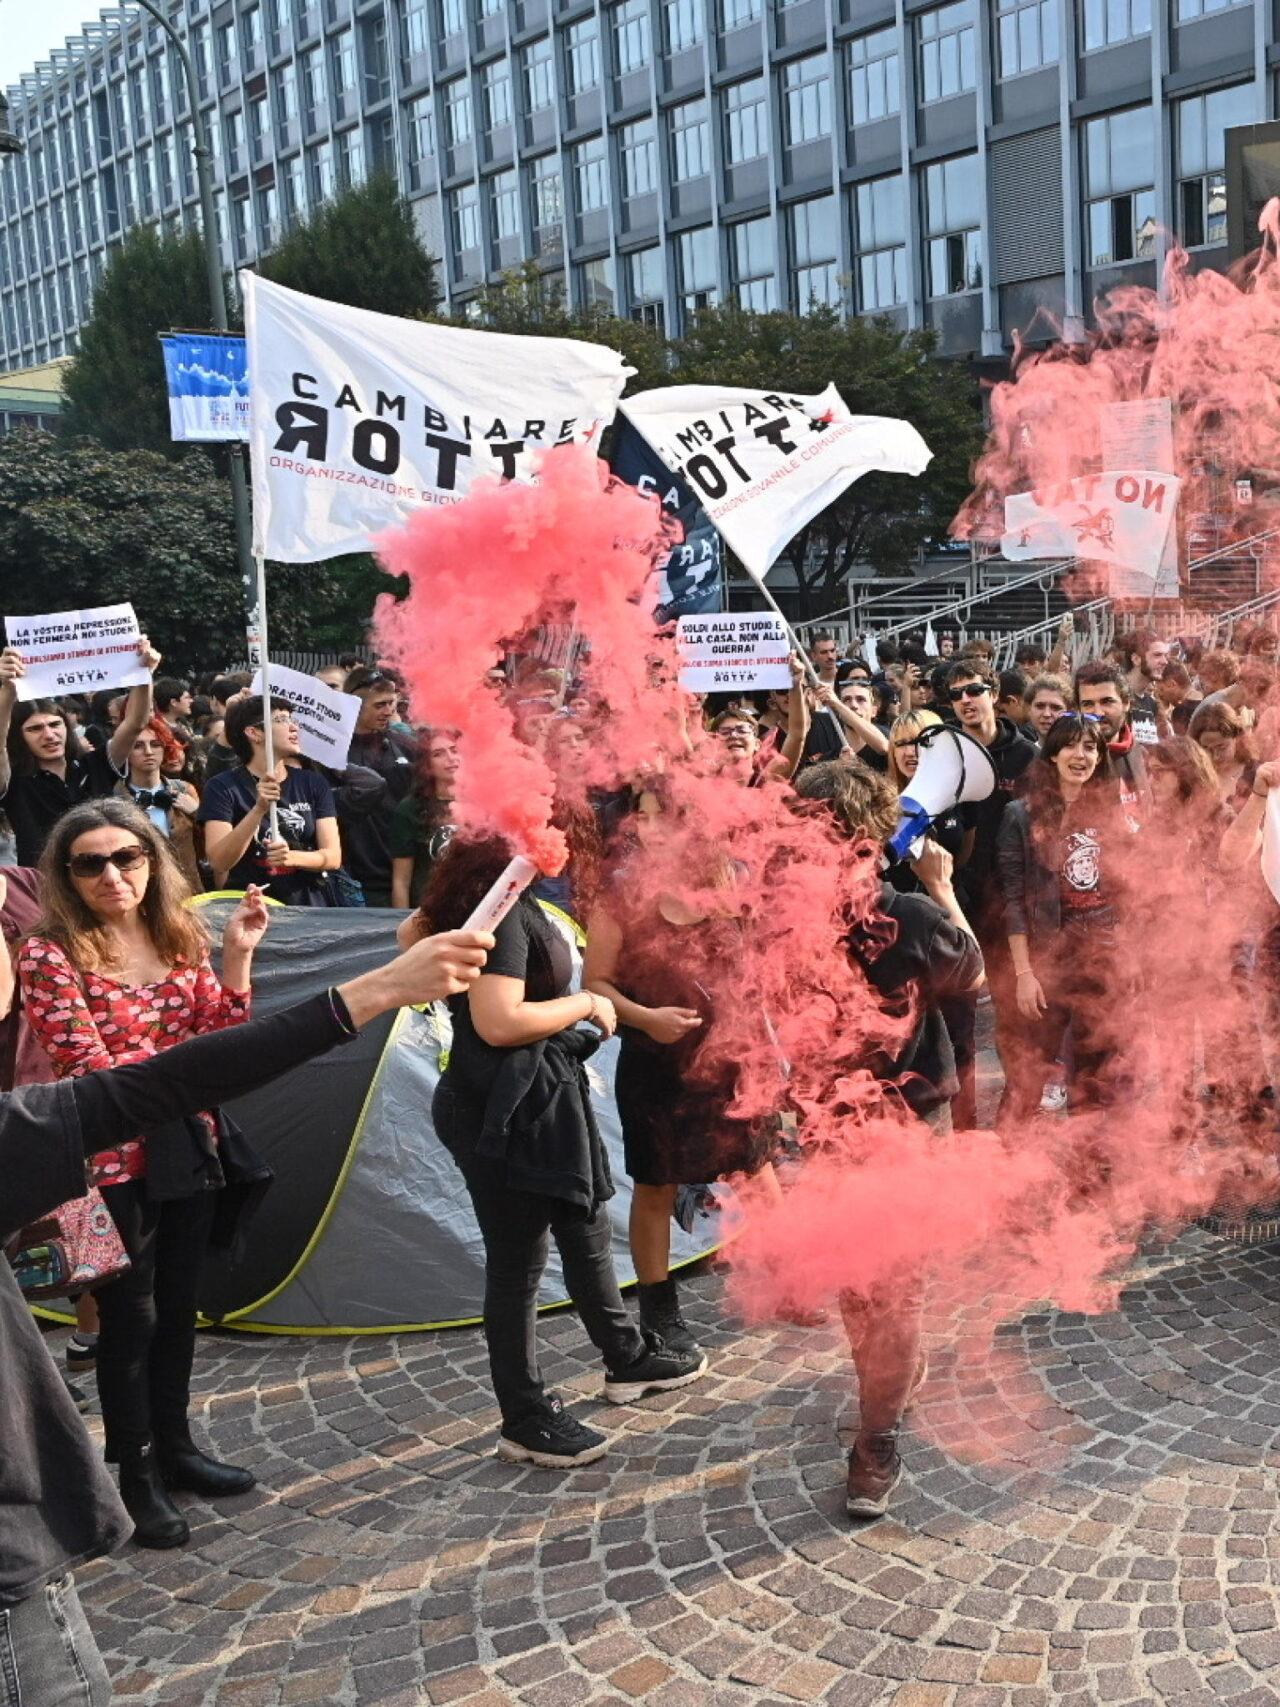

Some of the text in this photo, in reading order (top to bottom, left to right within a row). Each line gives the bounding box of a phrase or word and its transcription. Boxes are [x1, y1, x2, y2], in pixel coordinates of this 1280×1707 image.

[291, 371, 577, 441] CAMBIARE
[274, 400, 575, 491] ROTT
[269, 455, 416, 498] ORGANIZZAZIONE
[16, 628, 30, 638] LA
[33, 625, 71, 636] VOSTRA
[682, 621, 781, 633] SOLDI ALLO STUDIO E
[10, 637, 31, 647] NON
[82, 631, 98, 640] NOI
[739, 632, 760, 642] NON
[763, 630, 787, 641] ALLA
